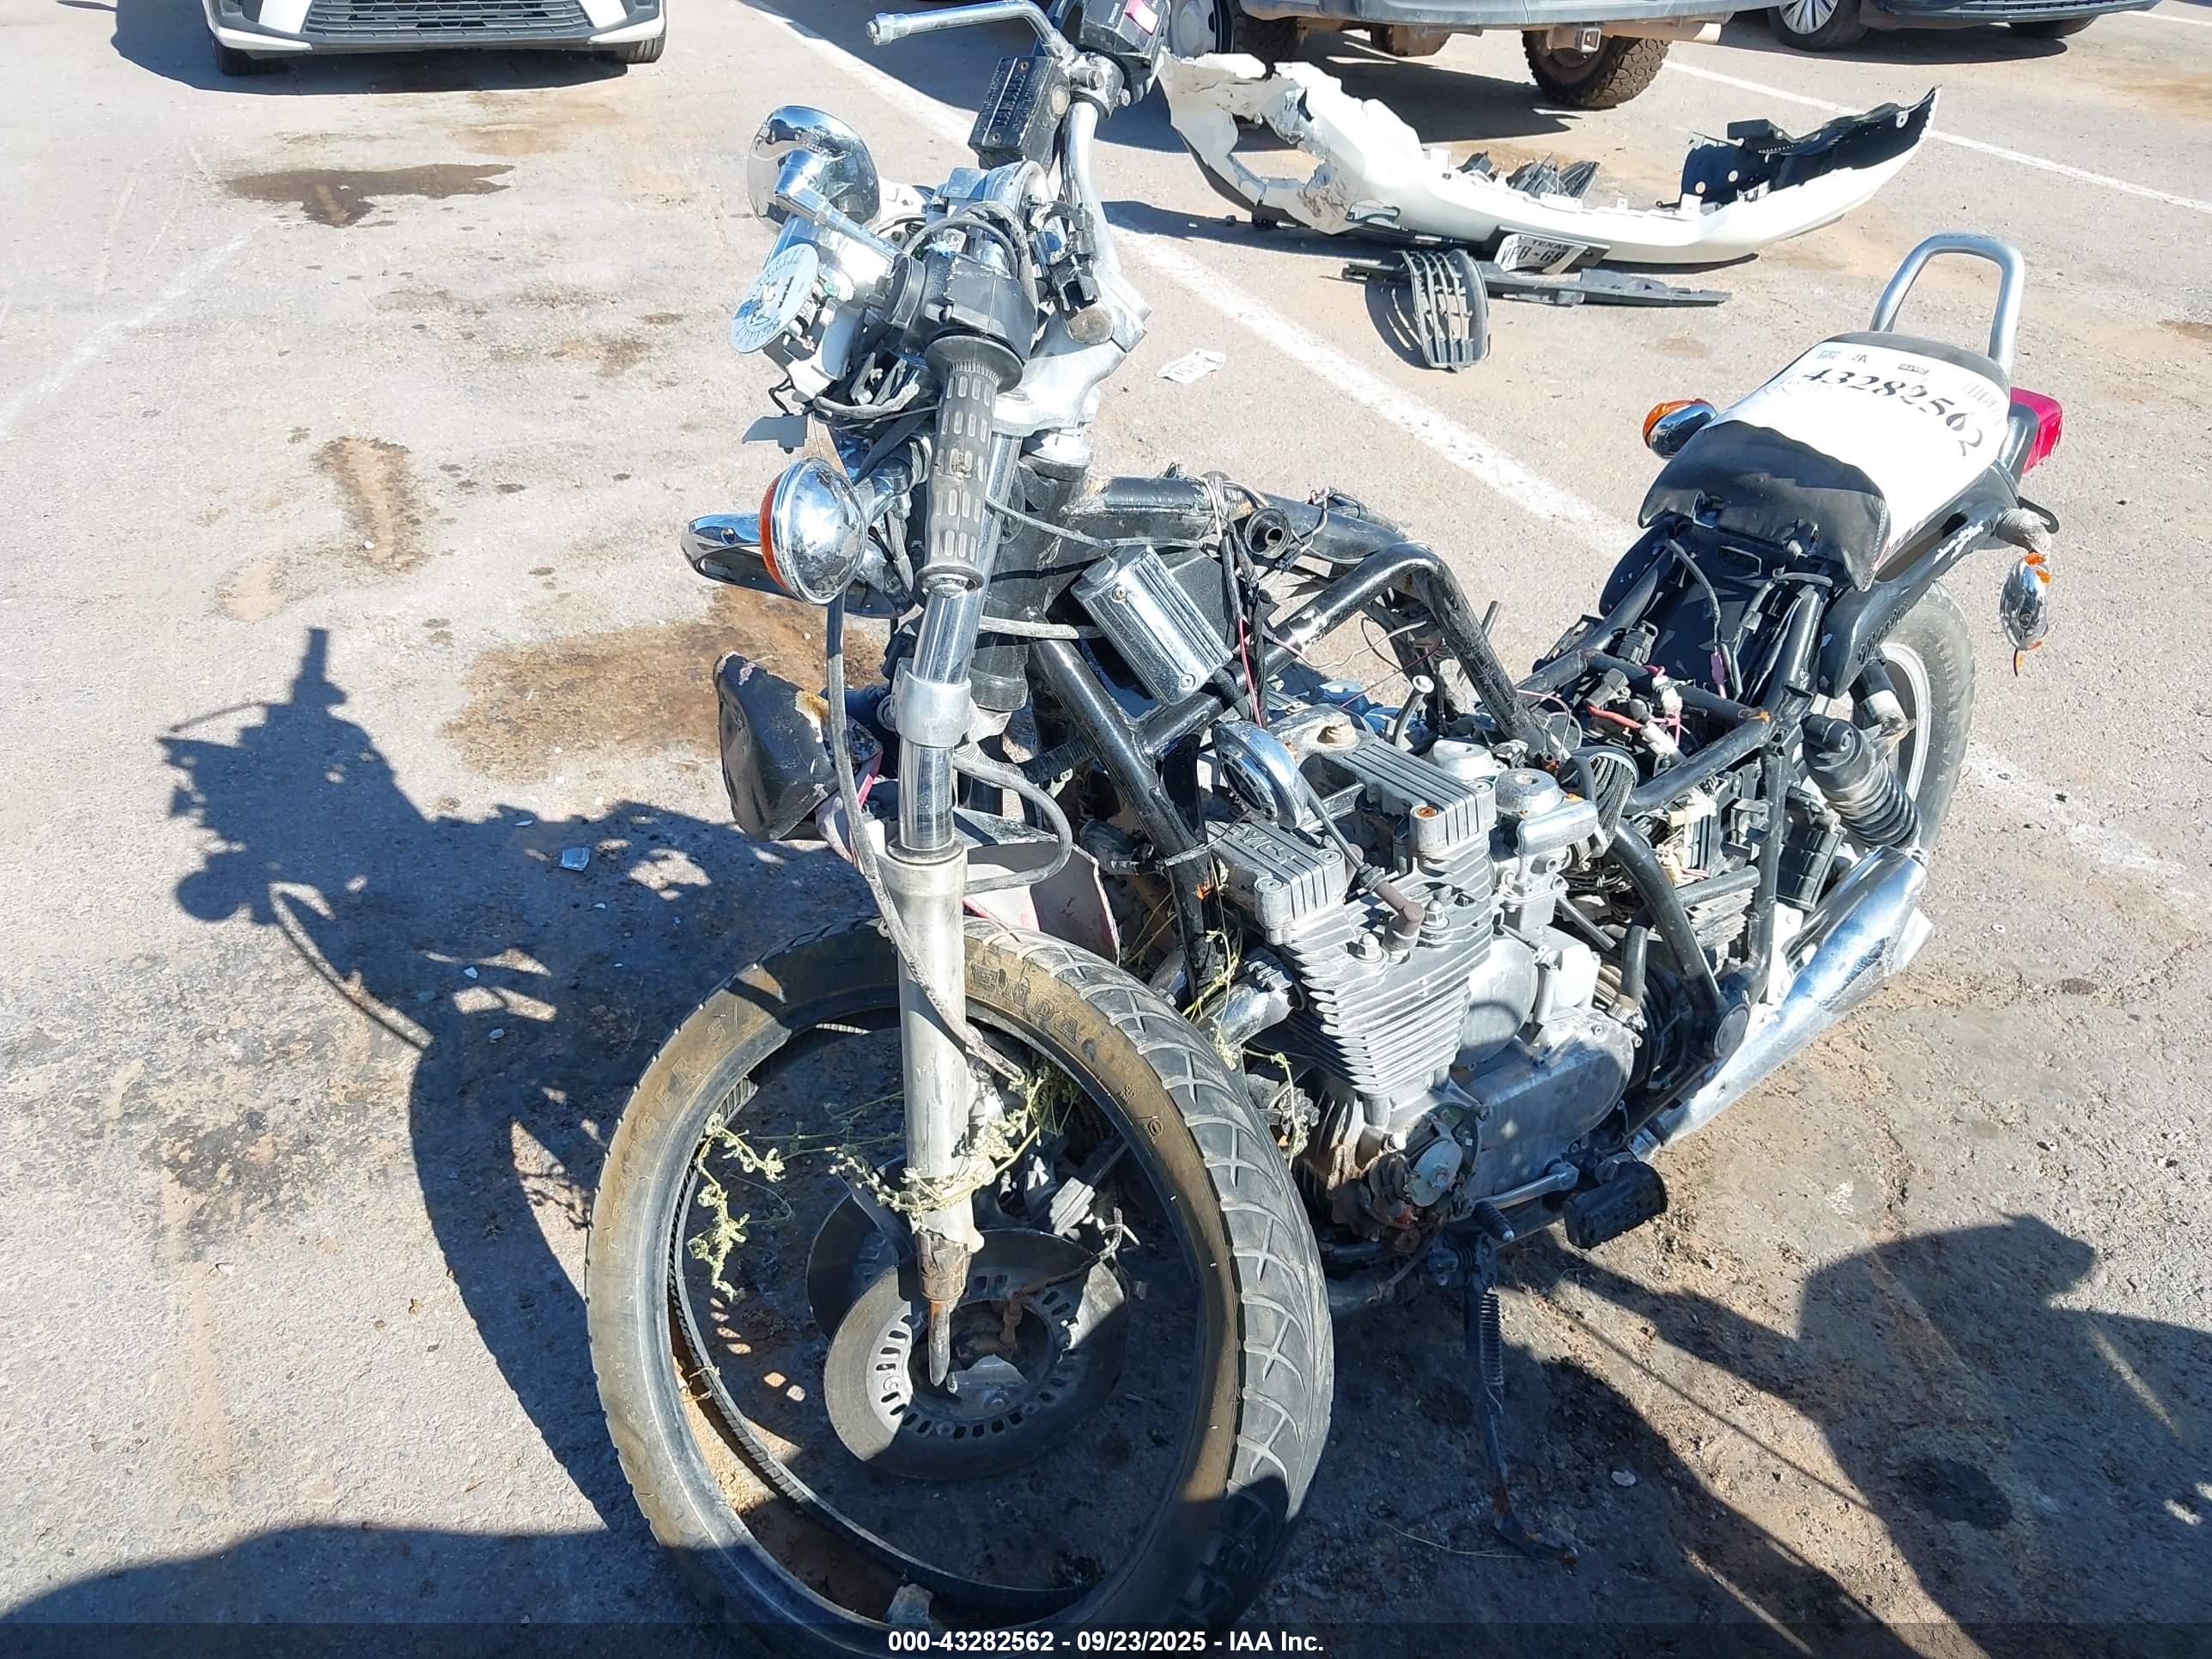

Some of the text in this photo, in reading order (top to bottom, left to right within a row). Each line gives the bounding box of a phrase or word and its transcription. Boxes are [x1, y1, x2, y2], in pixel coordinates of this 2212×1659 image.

[1108, 2, 1121, 24] ENGINE
[1802, 368, 1984, 457] 43282562
[969, 961, 1079, 1045] ENDA
